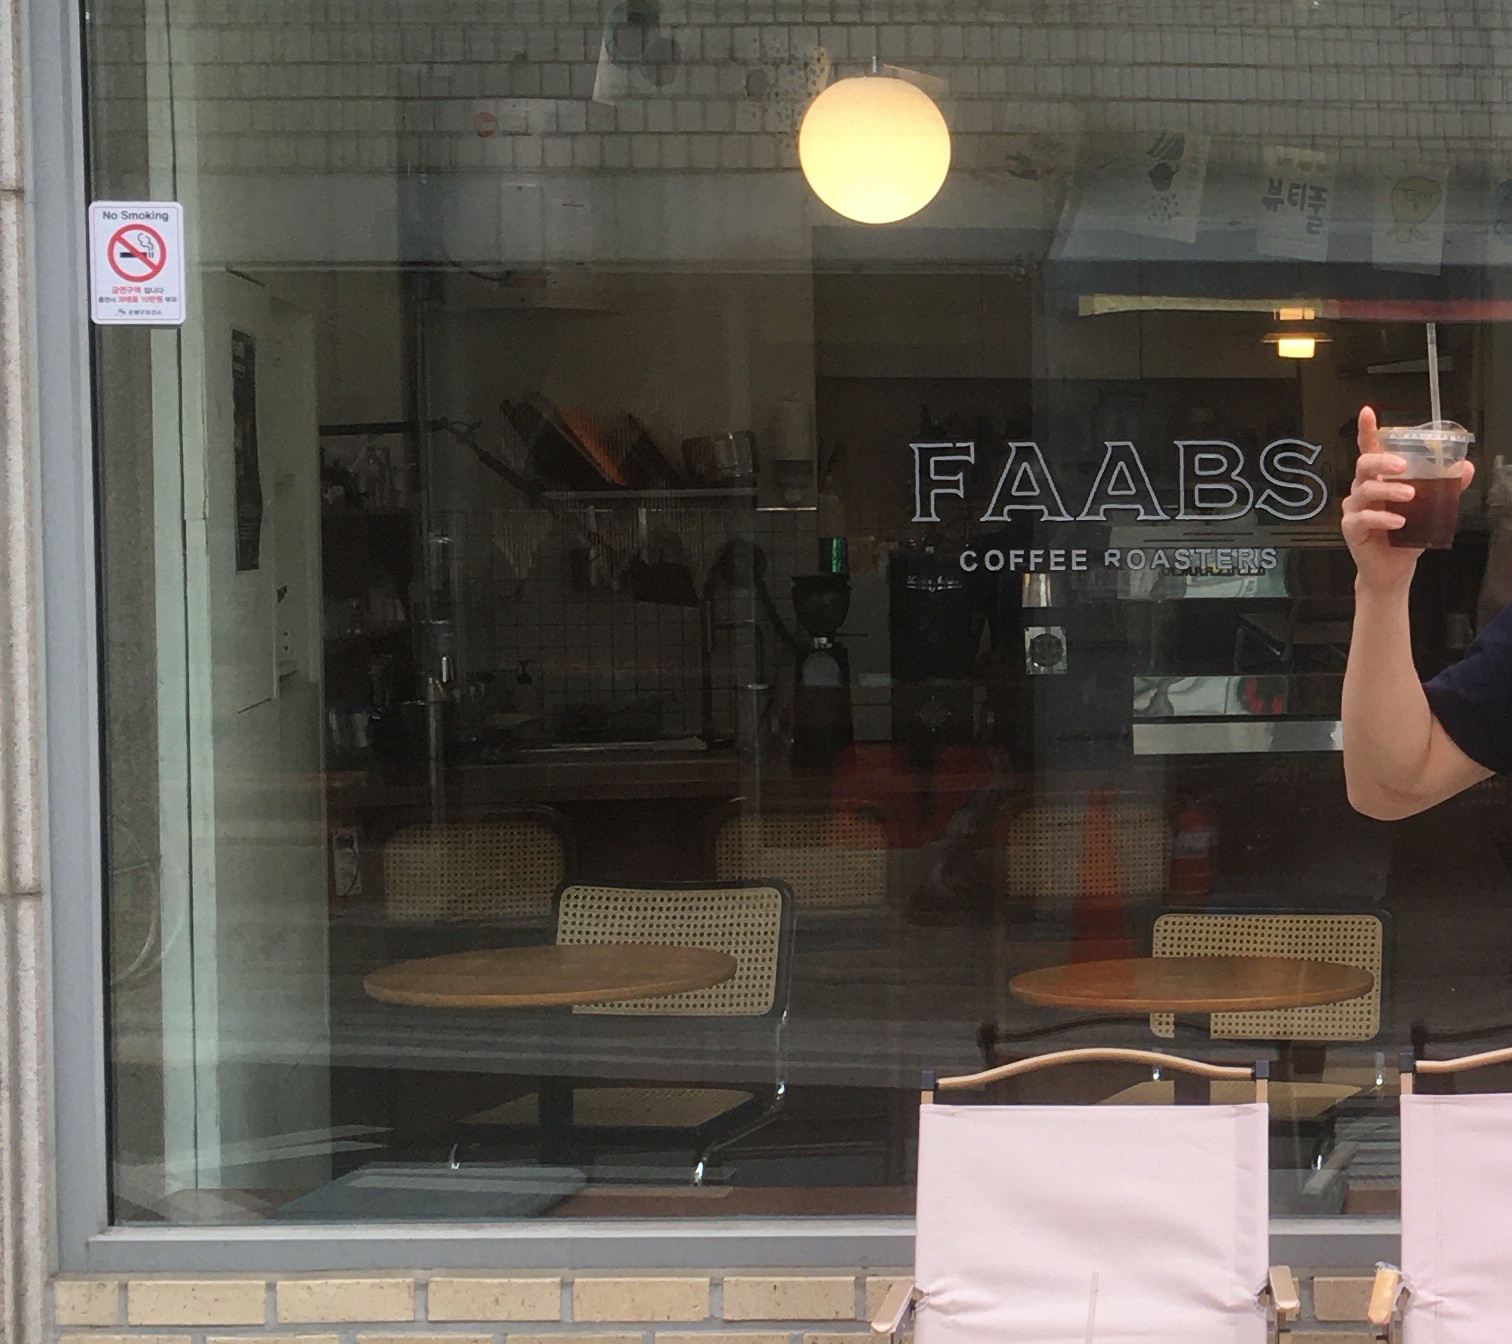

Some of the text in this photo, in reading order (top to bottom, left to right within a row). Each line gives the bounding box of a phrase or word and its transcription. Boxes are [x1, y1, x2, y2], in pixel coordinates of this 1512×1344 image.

[102, 210, 169, 222] No Smoking
[1262, 177, 1328, 235] 뷰티풀
[112, 286, 142, 295] 금연구역
[909, 438, 1328, 523] FAABS
[959, 547, 1278, 571] COFFEE ROASTERS
